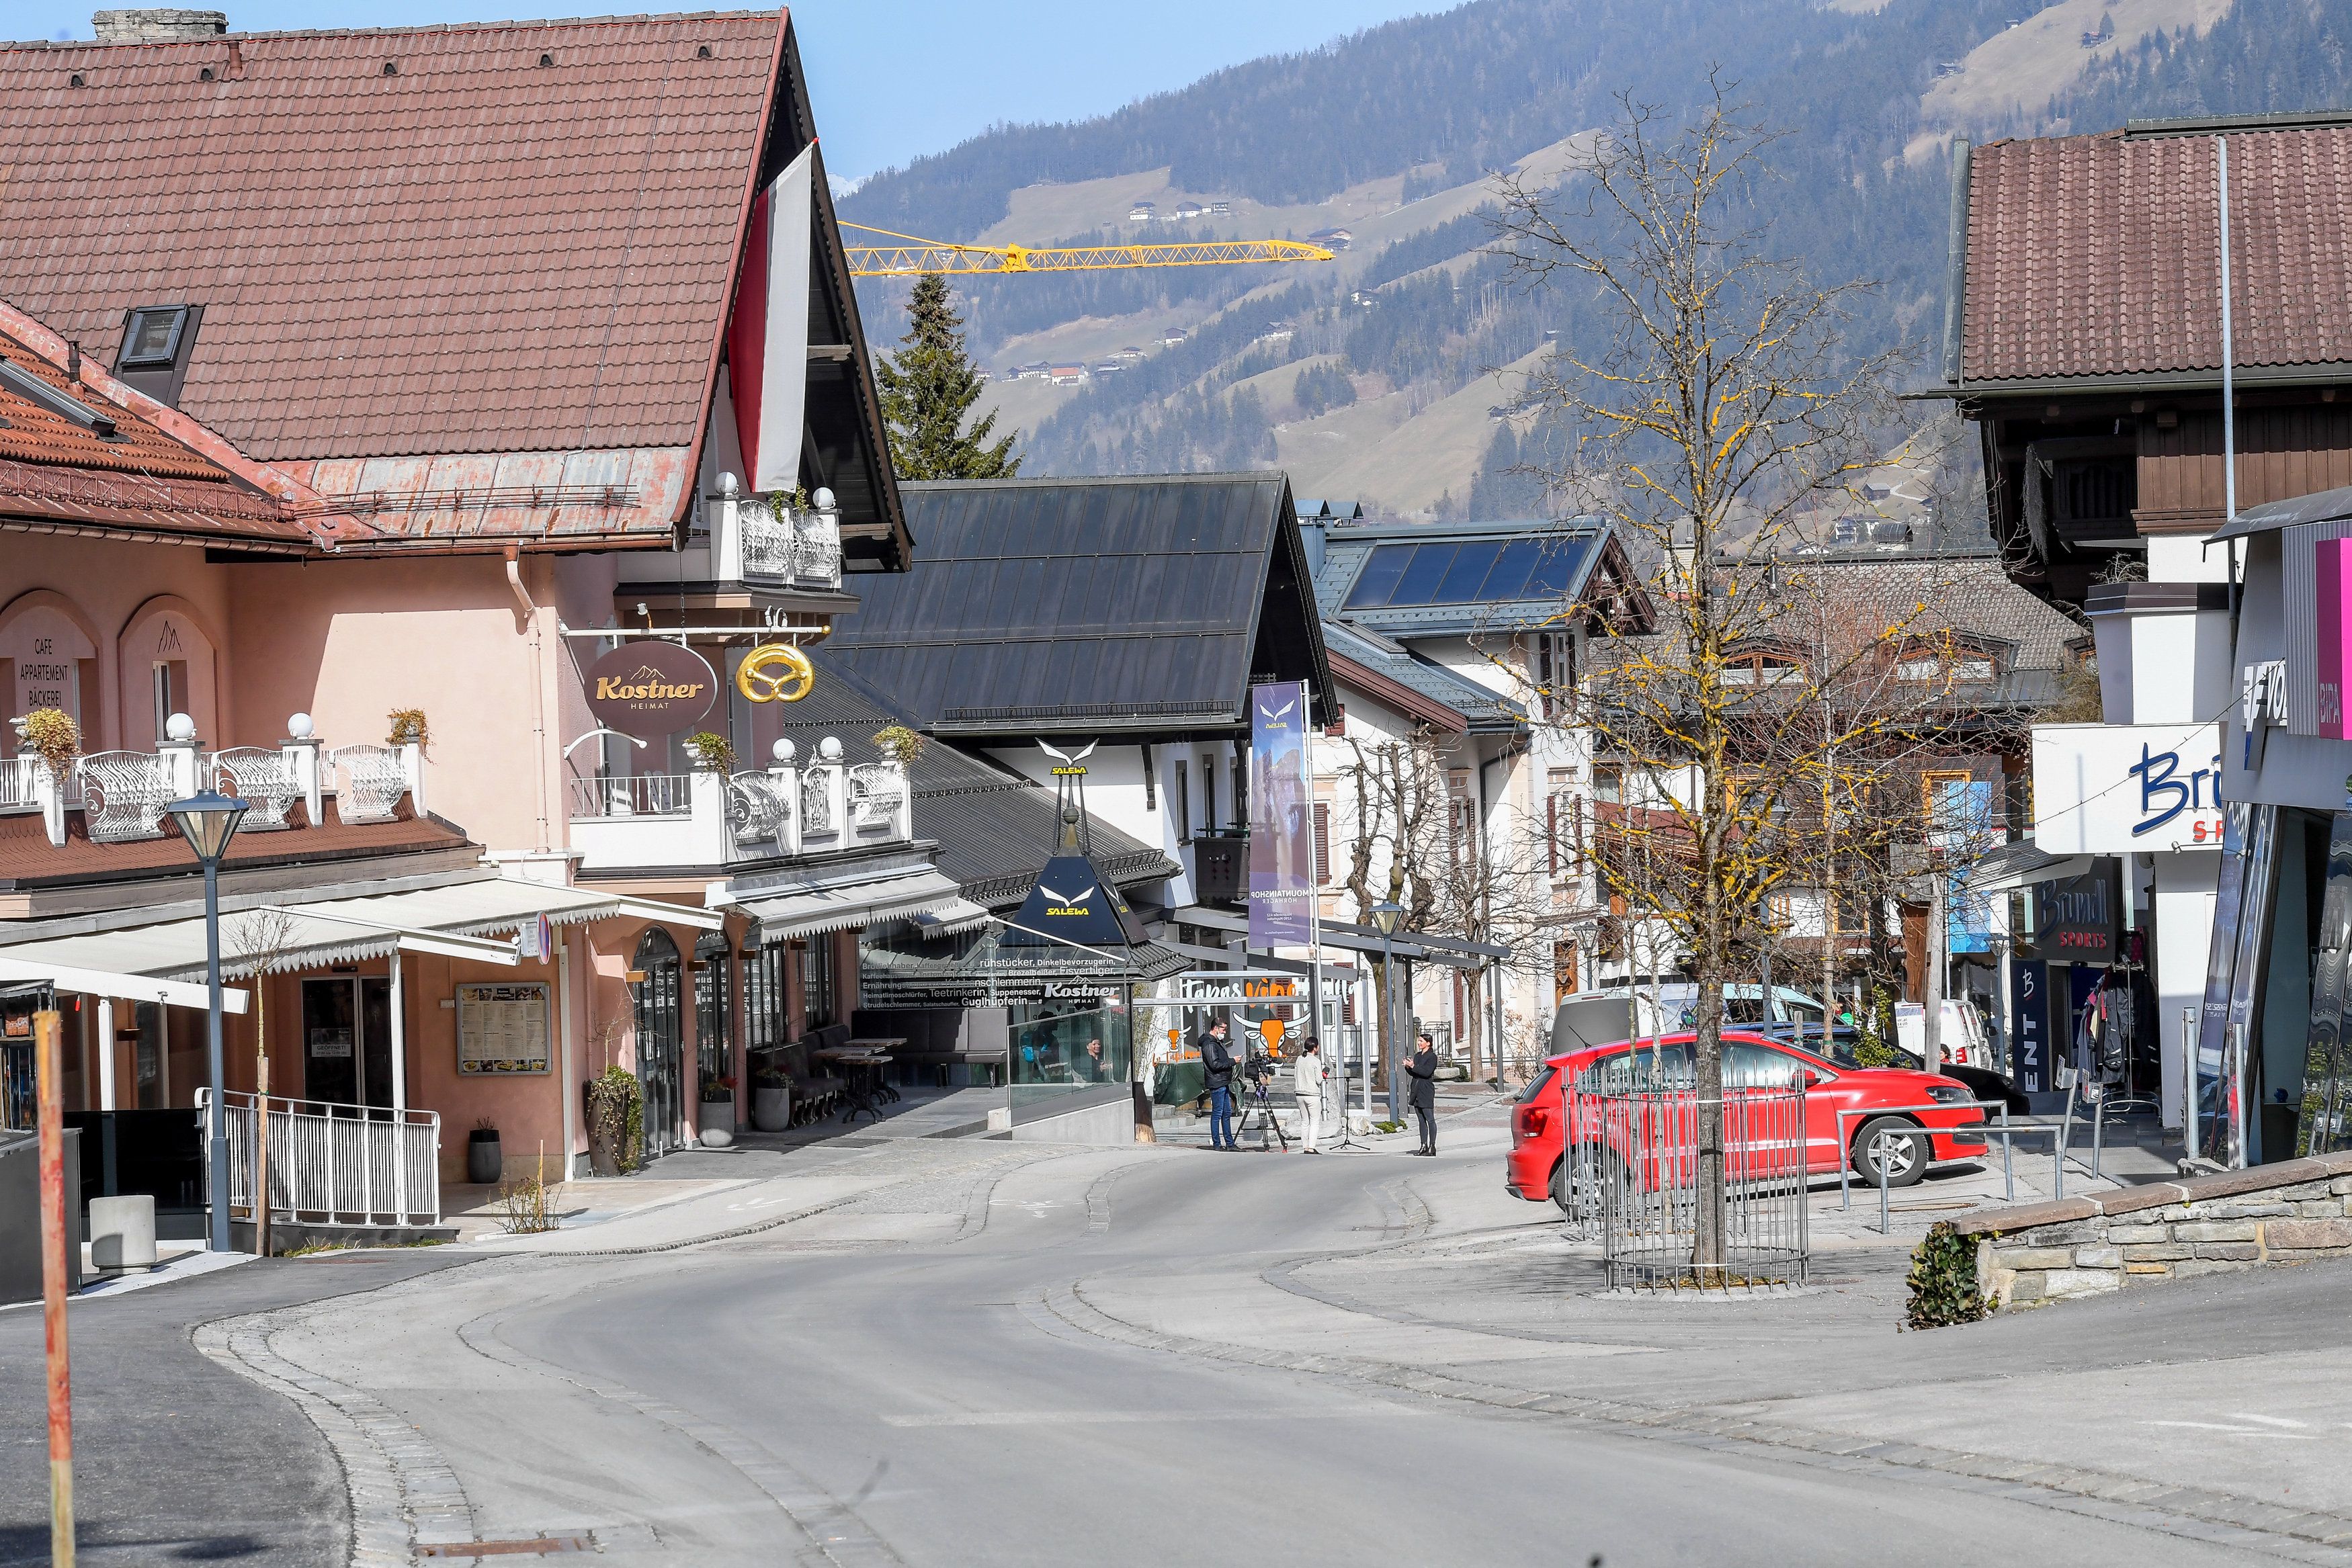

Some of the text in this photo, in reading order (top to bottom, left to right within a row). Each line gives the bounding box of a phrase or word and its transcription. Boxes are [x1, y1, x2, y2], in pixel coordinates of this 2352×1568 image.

[35, 638, 52, 655] CAFE
[20, 664, 68, 681] APPARTEMENT
[596, 675, 704, 700] Kostner
[29, 687, 62, 706] BÄCKEREI
[2320, 683, 2341, 724] BIPA
[630, 702, 669, 710] HEIMAT
[1052, 767, 1087, 775] SALEWA
[1046, 908, 1089, 916] SALEWA
[2058, 931, 2107, 949] SPORTS
[1037, 958, 1116, 967] Dinkelbevorzugerin,
[1008, 969, 1058, 977] Brezelbeißer,
[1060, 966, 1116, 977] Eisvertilger,
[929, 987, 988, 997] Teetrinkerin,
[991, 989, 1042, 997] Suppenesser,
[1044, 983, 1120, 998] Kostner
